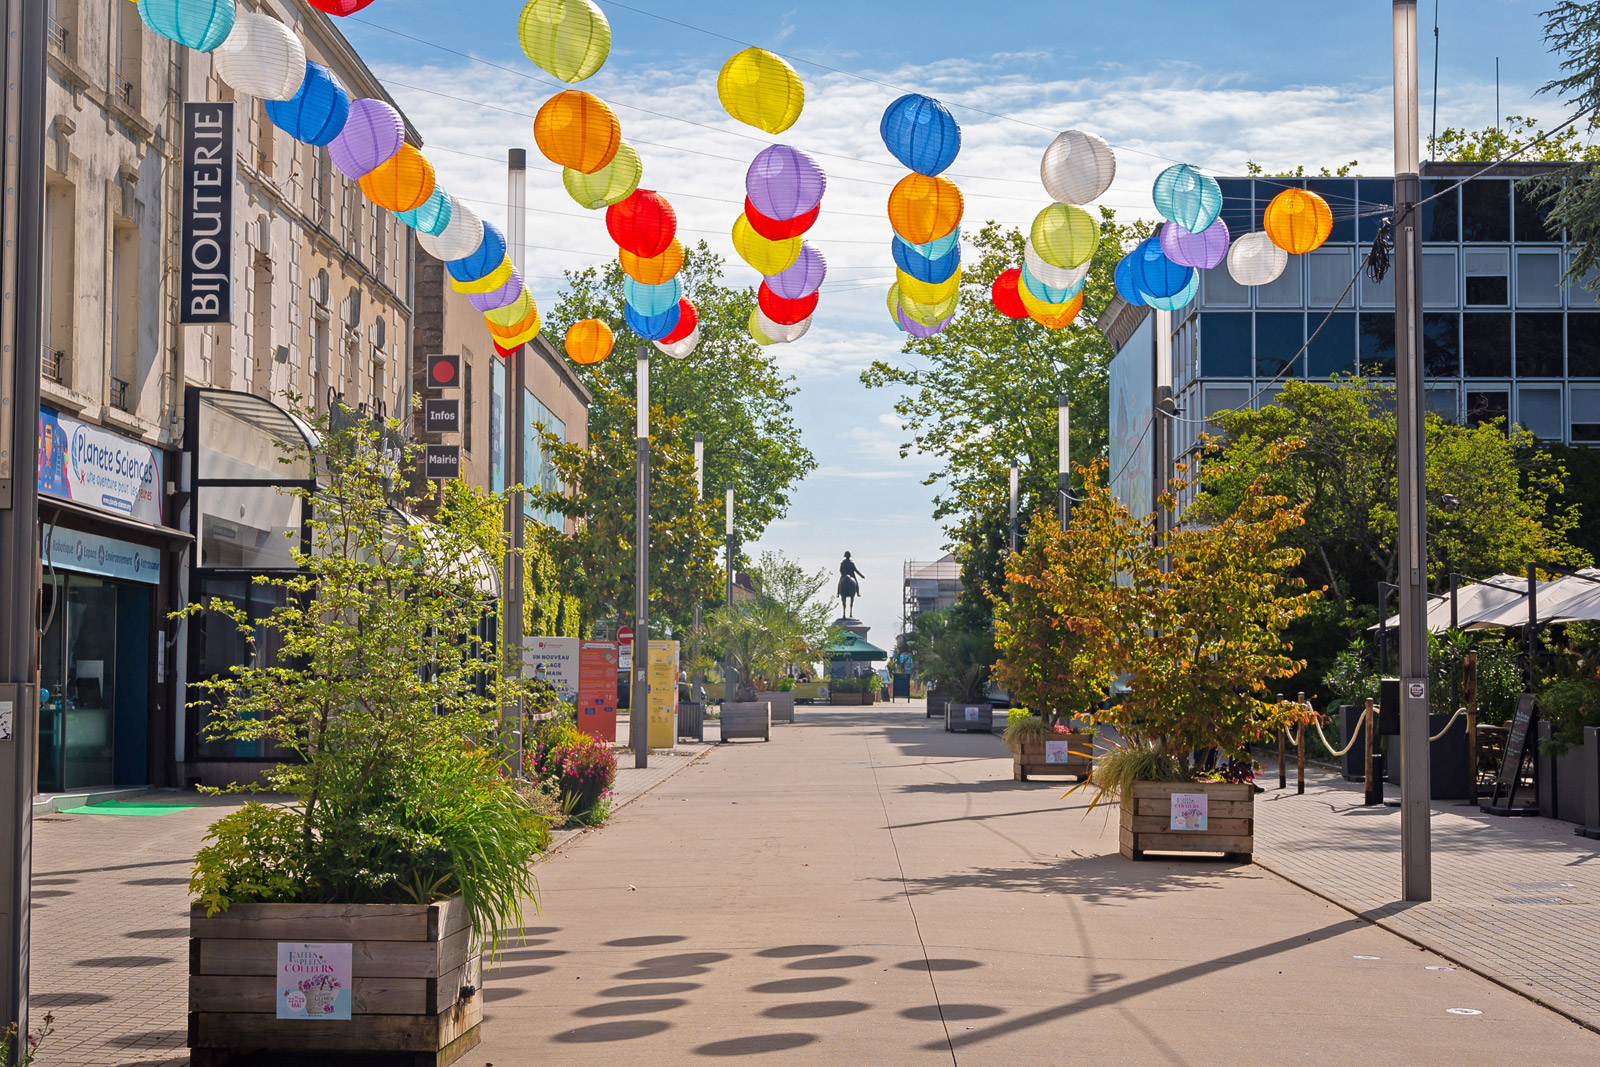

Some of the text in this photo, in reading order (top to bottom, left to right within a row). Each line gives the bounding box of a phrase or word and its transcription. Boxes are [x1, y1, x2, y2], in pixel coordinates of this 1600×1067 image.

[190, 109, 229, 316] BIJOUTERIE
[430, 411, 455, 420] Infos
[115, 449, 153, 484] Sciences
[429, 454, 457, 464] Mairie
[97, 475, 117, 492] aventure
[52, 540, 74, 556] Robotique
[84, 546, 97, 559] Espace
[106, 550, 133, 566] Environnement
[284, 964, 334, 973] COULEURS
